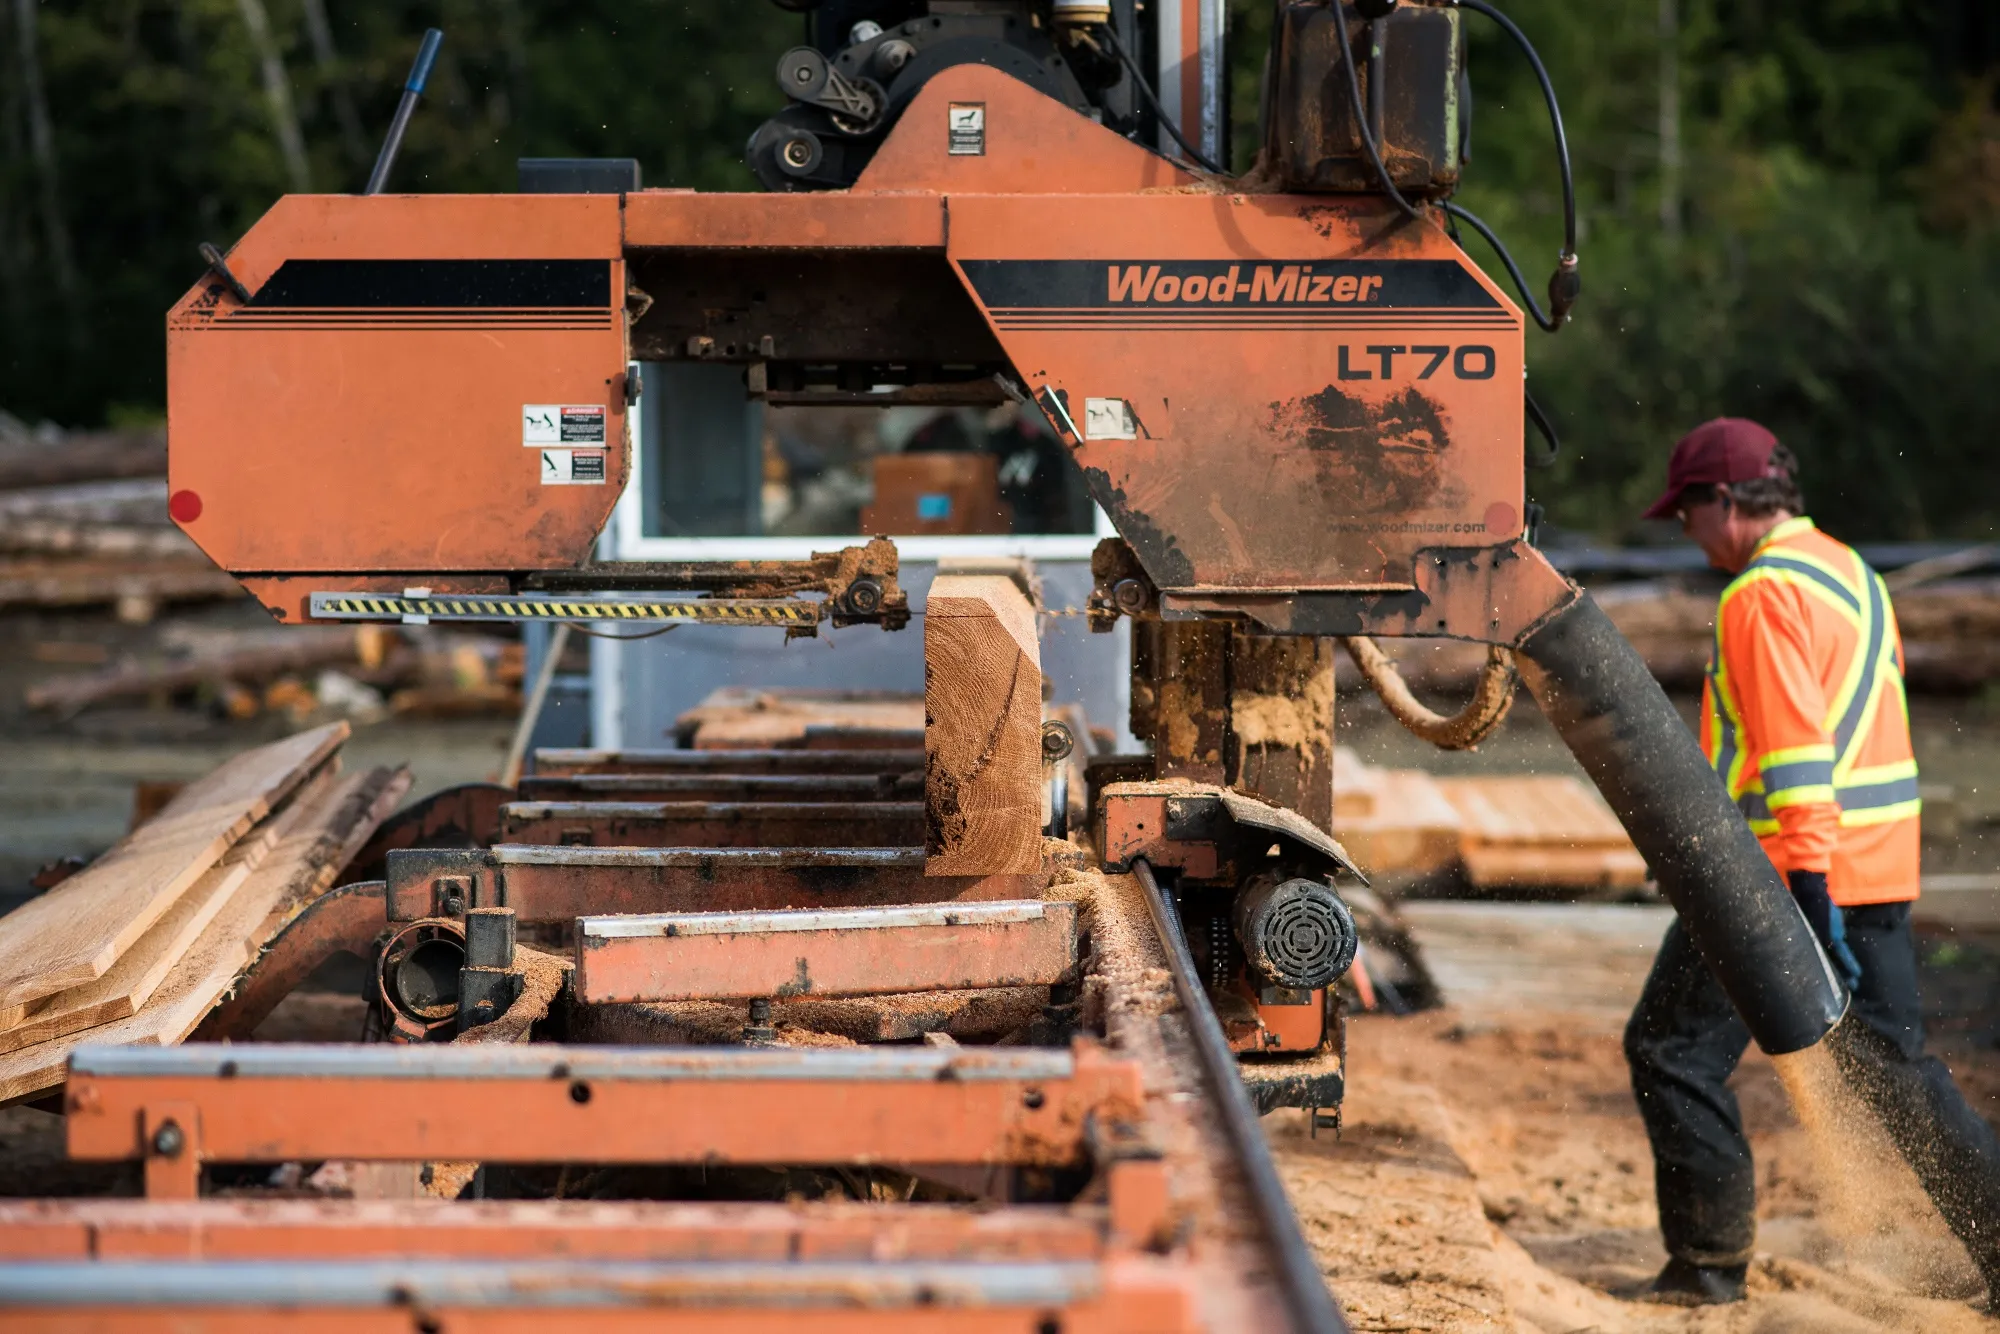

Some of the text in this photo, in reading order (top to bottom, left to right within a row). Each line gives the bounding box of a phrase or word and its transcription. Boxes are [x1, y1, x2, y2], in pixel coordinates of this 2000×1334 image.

[1107, 265, 1383, 303] Wood-Mizer
[1337, 344, 1496, 381] LT70
[1326, 520, 1486, 534] www.woodmizer.com
